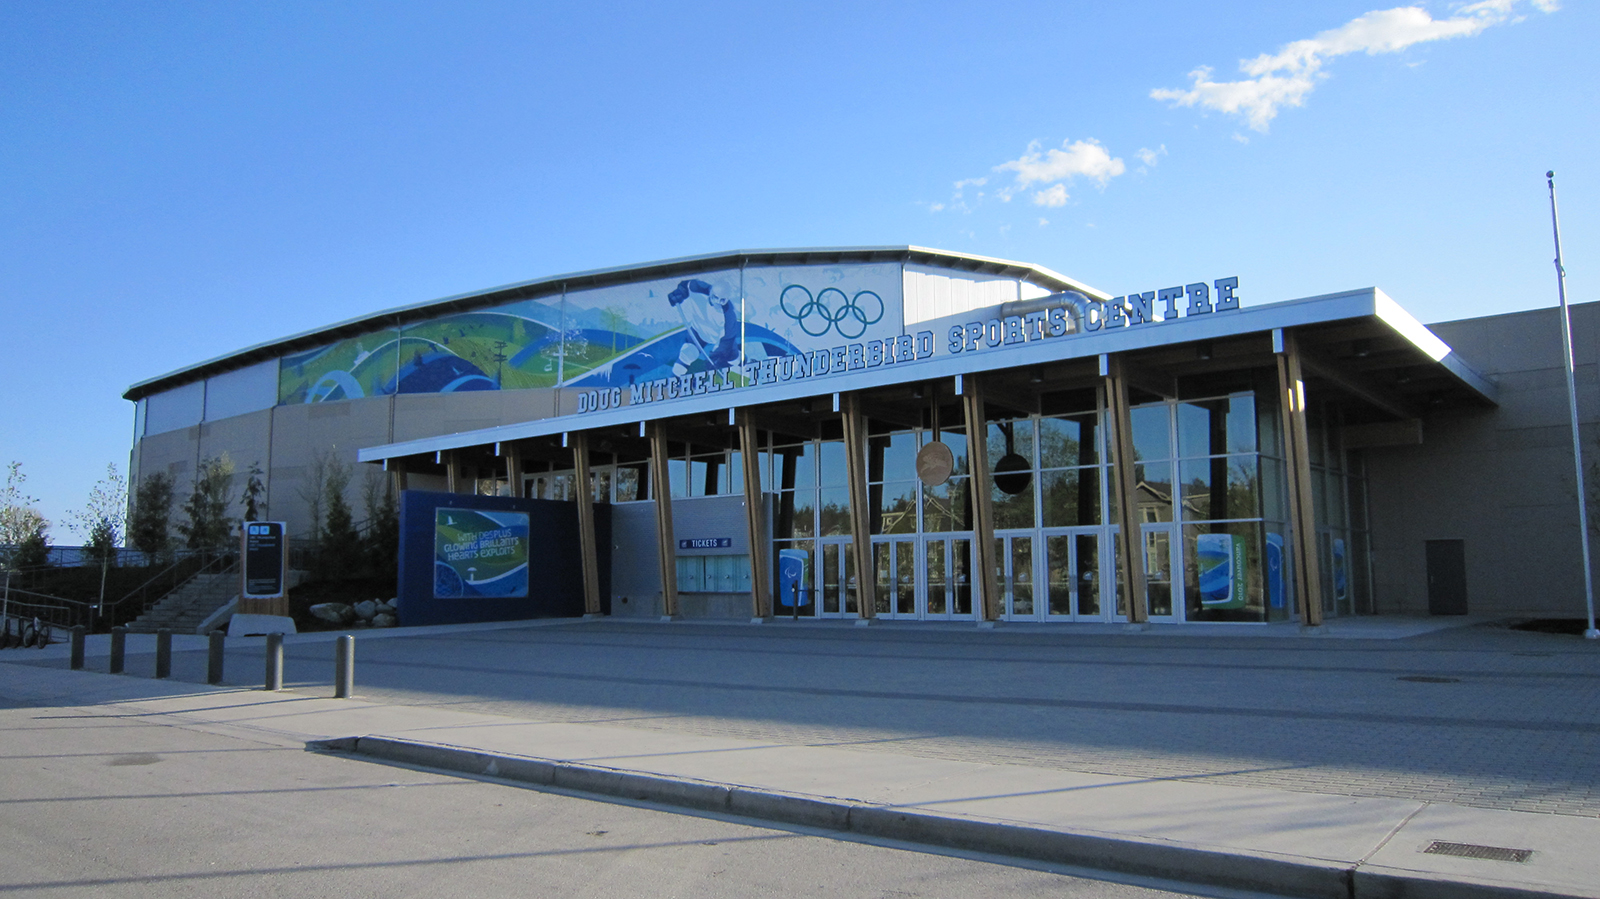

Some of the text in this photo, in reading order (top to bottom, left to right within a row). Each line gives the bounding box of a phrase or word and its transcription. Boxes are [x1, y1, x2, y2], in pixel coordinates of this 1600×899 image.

[578, 276, 1240, 414] DOUG MITCHELL THUNDERBIRD SPORTS CENTRE
[692, 539, 717, 548] TICKETS
